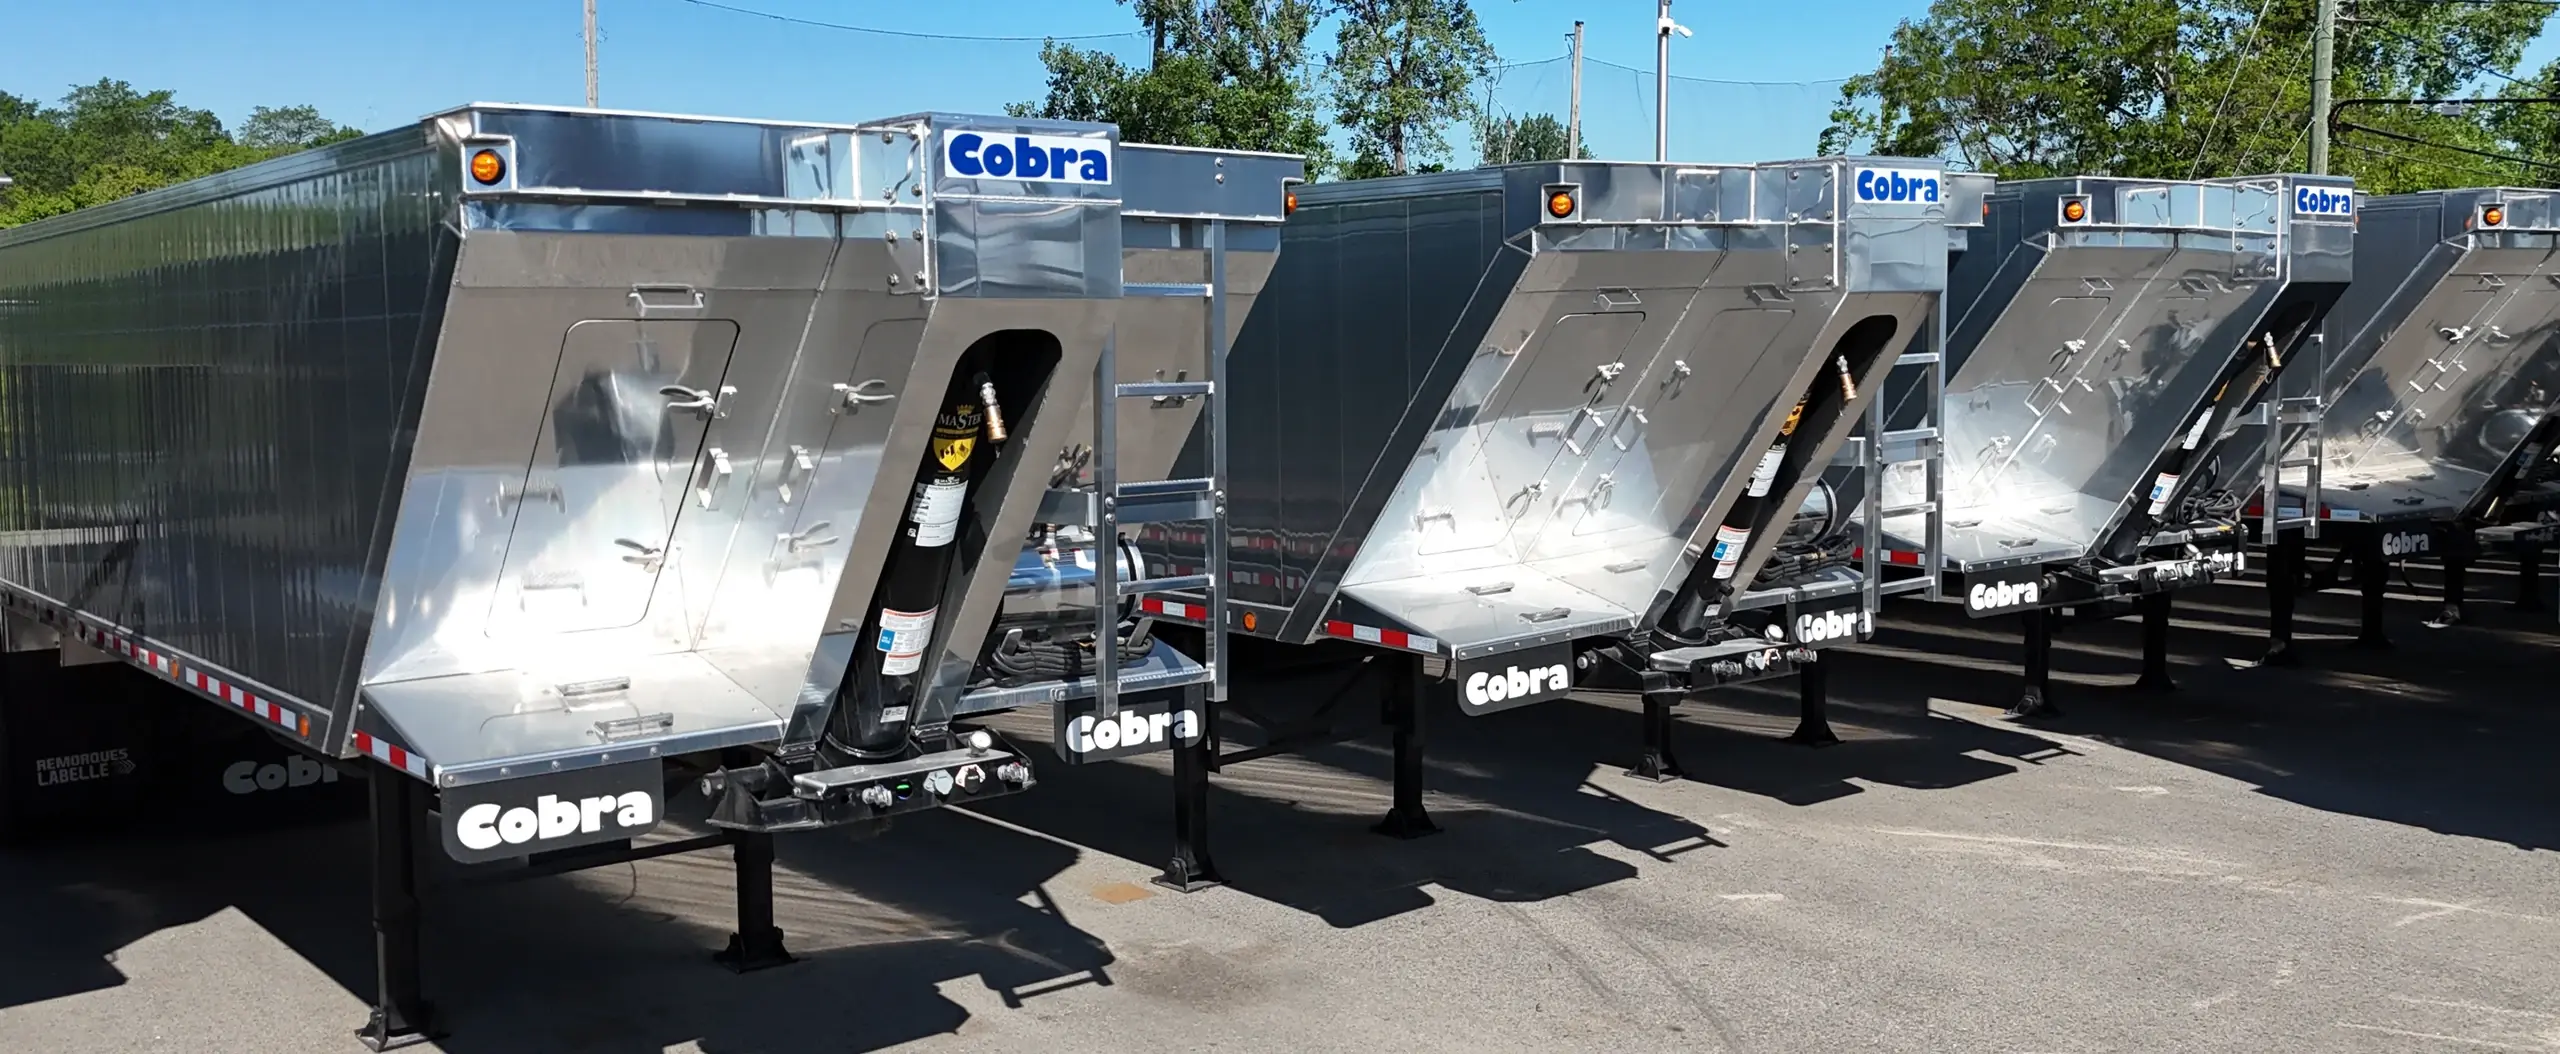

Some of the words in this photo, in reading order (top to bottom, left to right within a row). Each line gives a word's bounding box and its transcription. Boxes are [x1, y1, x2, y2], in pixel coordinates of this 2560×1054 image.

[949, 133, 1108, 182] Cobra
[1857, 169, 1938, 202] Cobra
[2297, 188, 2351, 213] Cobra
[2382, 531, 2429, 556] Cobra
[1969, 580, 2038, 611] Cobra
[1795, 610, 1872, 643] Cobra
[1465, 664, 1568, 706] Cobra
[1066, 709, 1198, 753] Cobra
[35, 747, 129, 771] REMORQUES
[36, 763, 110, 787] LABELLE
[456, 790, 653, 850] Cobra
